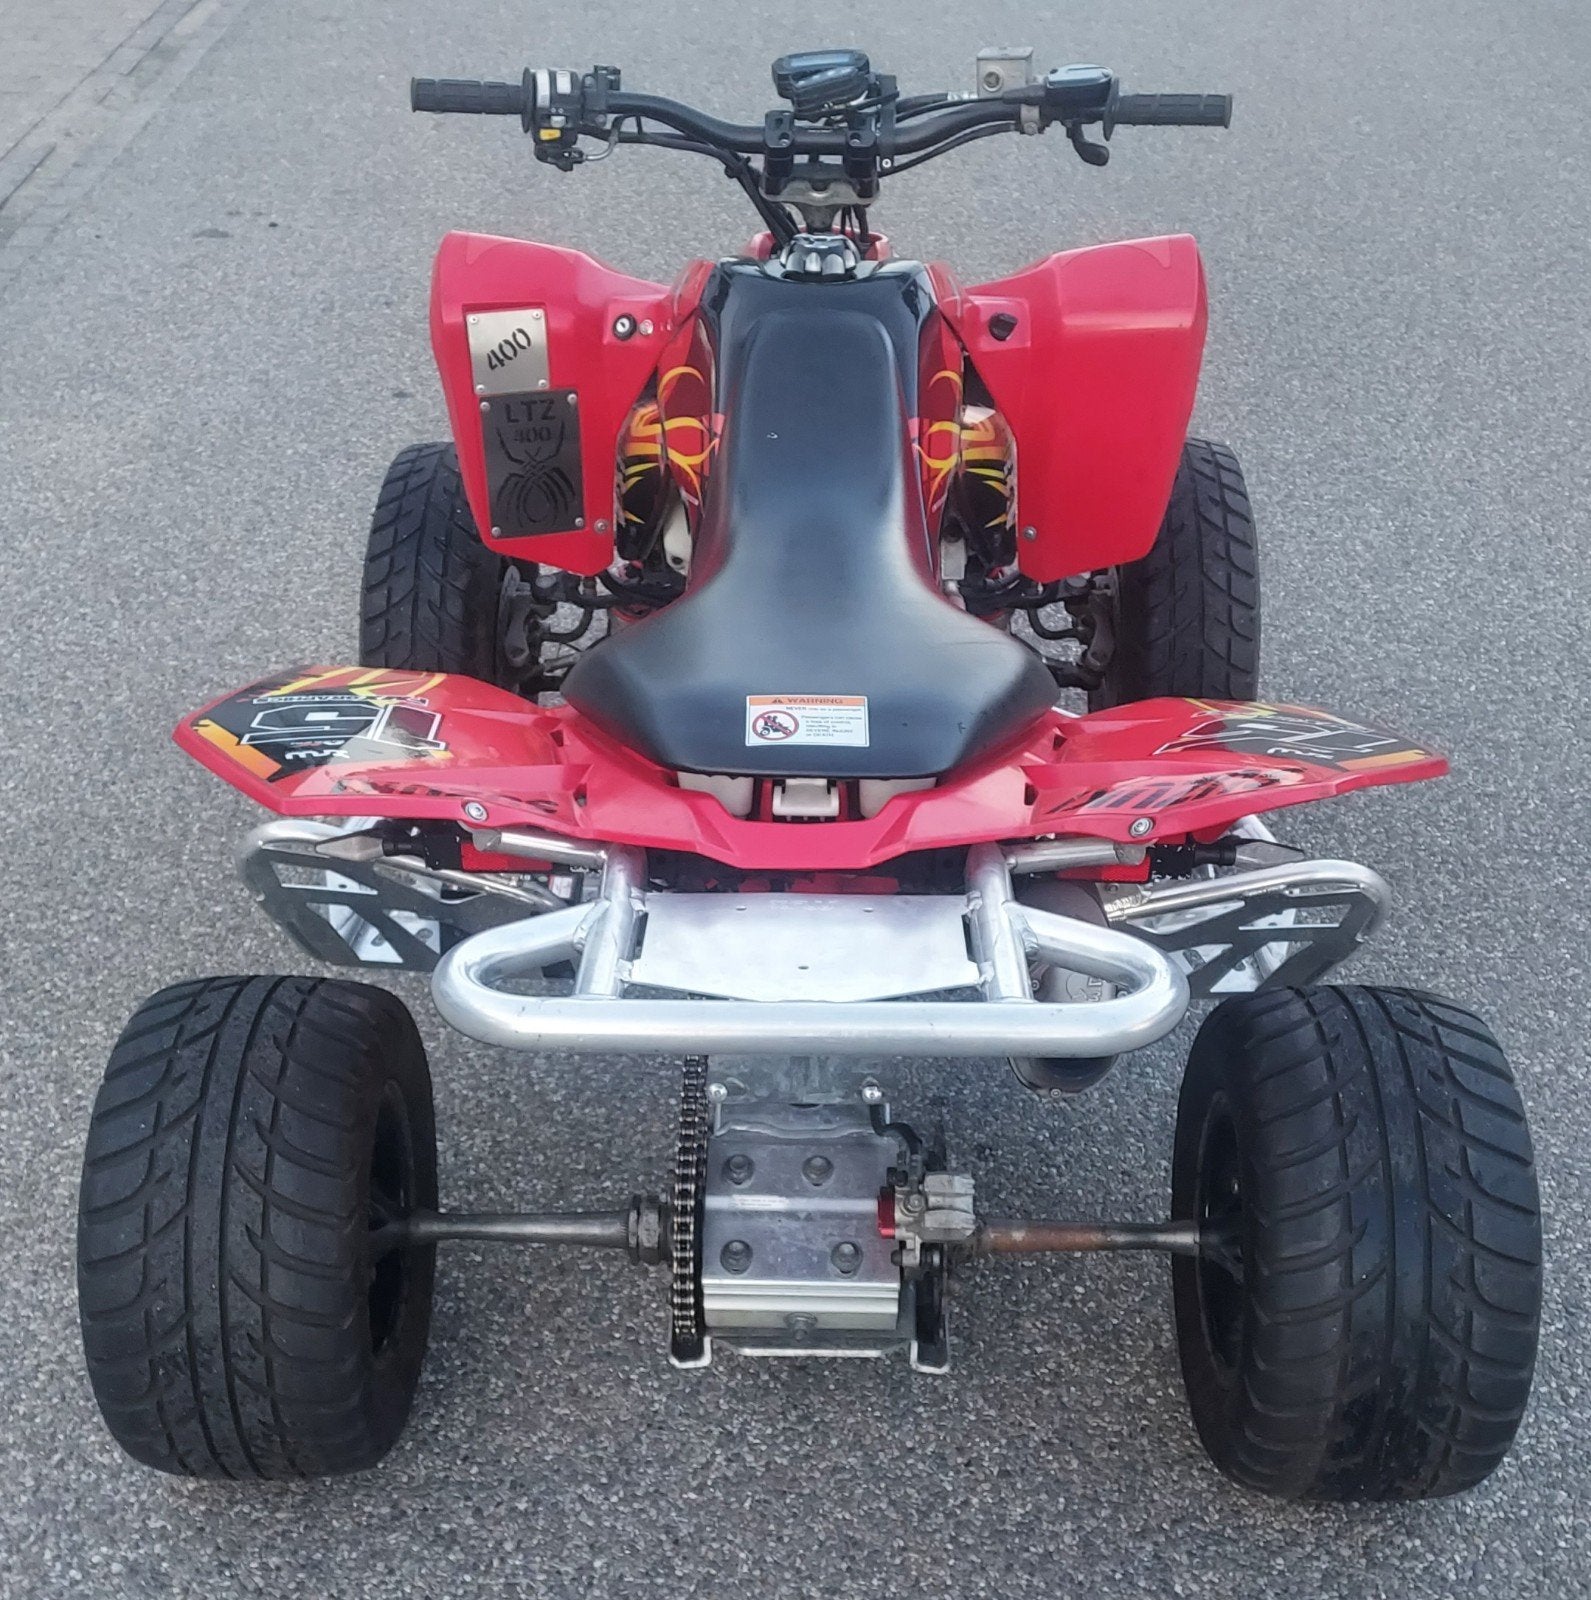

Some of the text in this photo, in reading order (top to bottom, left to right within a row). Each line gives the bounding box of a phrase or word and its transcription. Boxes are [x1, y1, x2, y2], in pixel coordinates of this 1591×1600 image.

[486, 328, 532, 370] 400
[505, 400, 556, 423] LTZ
[787, 697, 844, 705] WARNING
